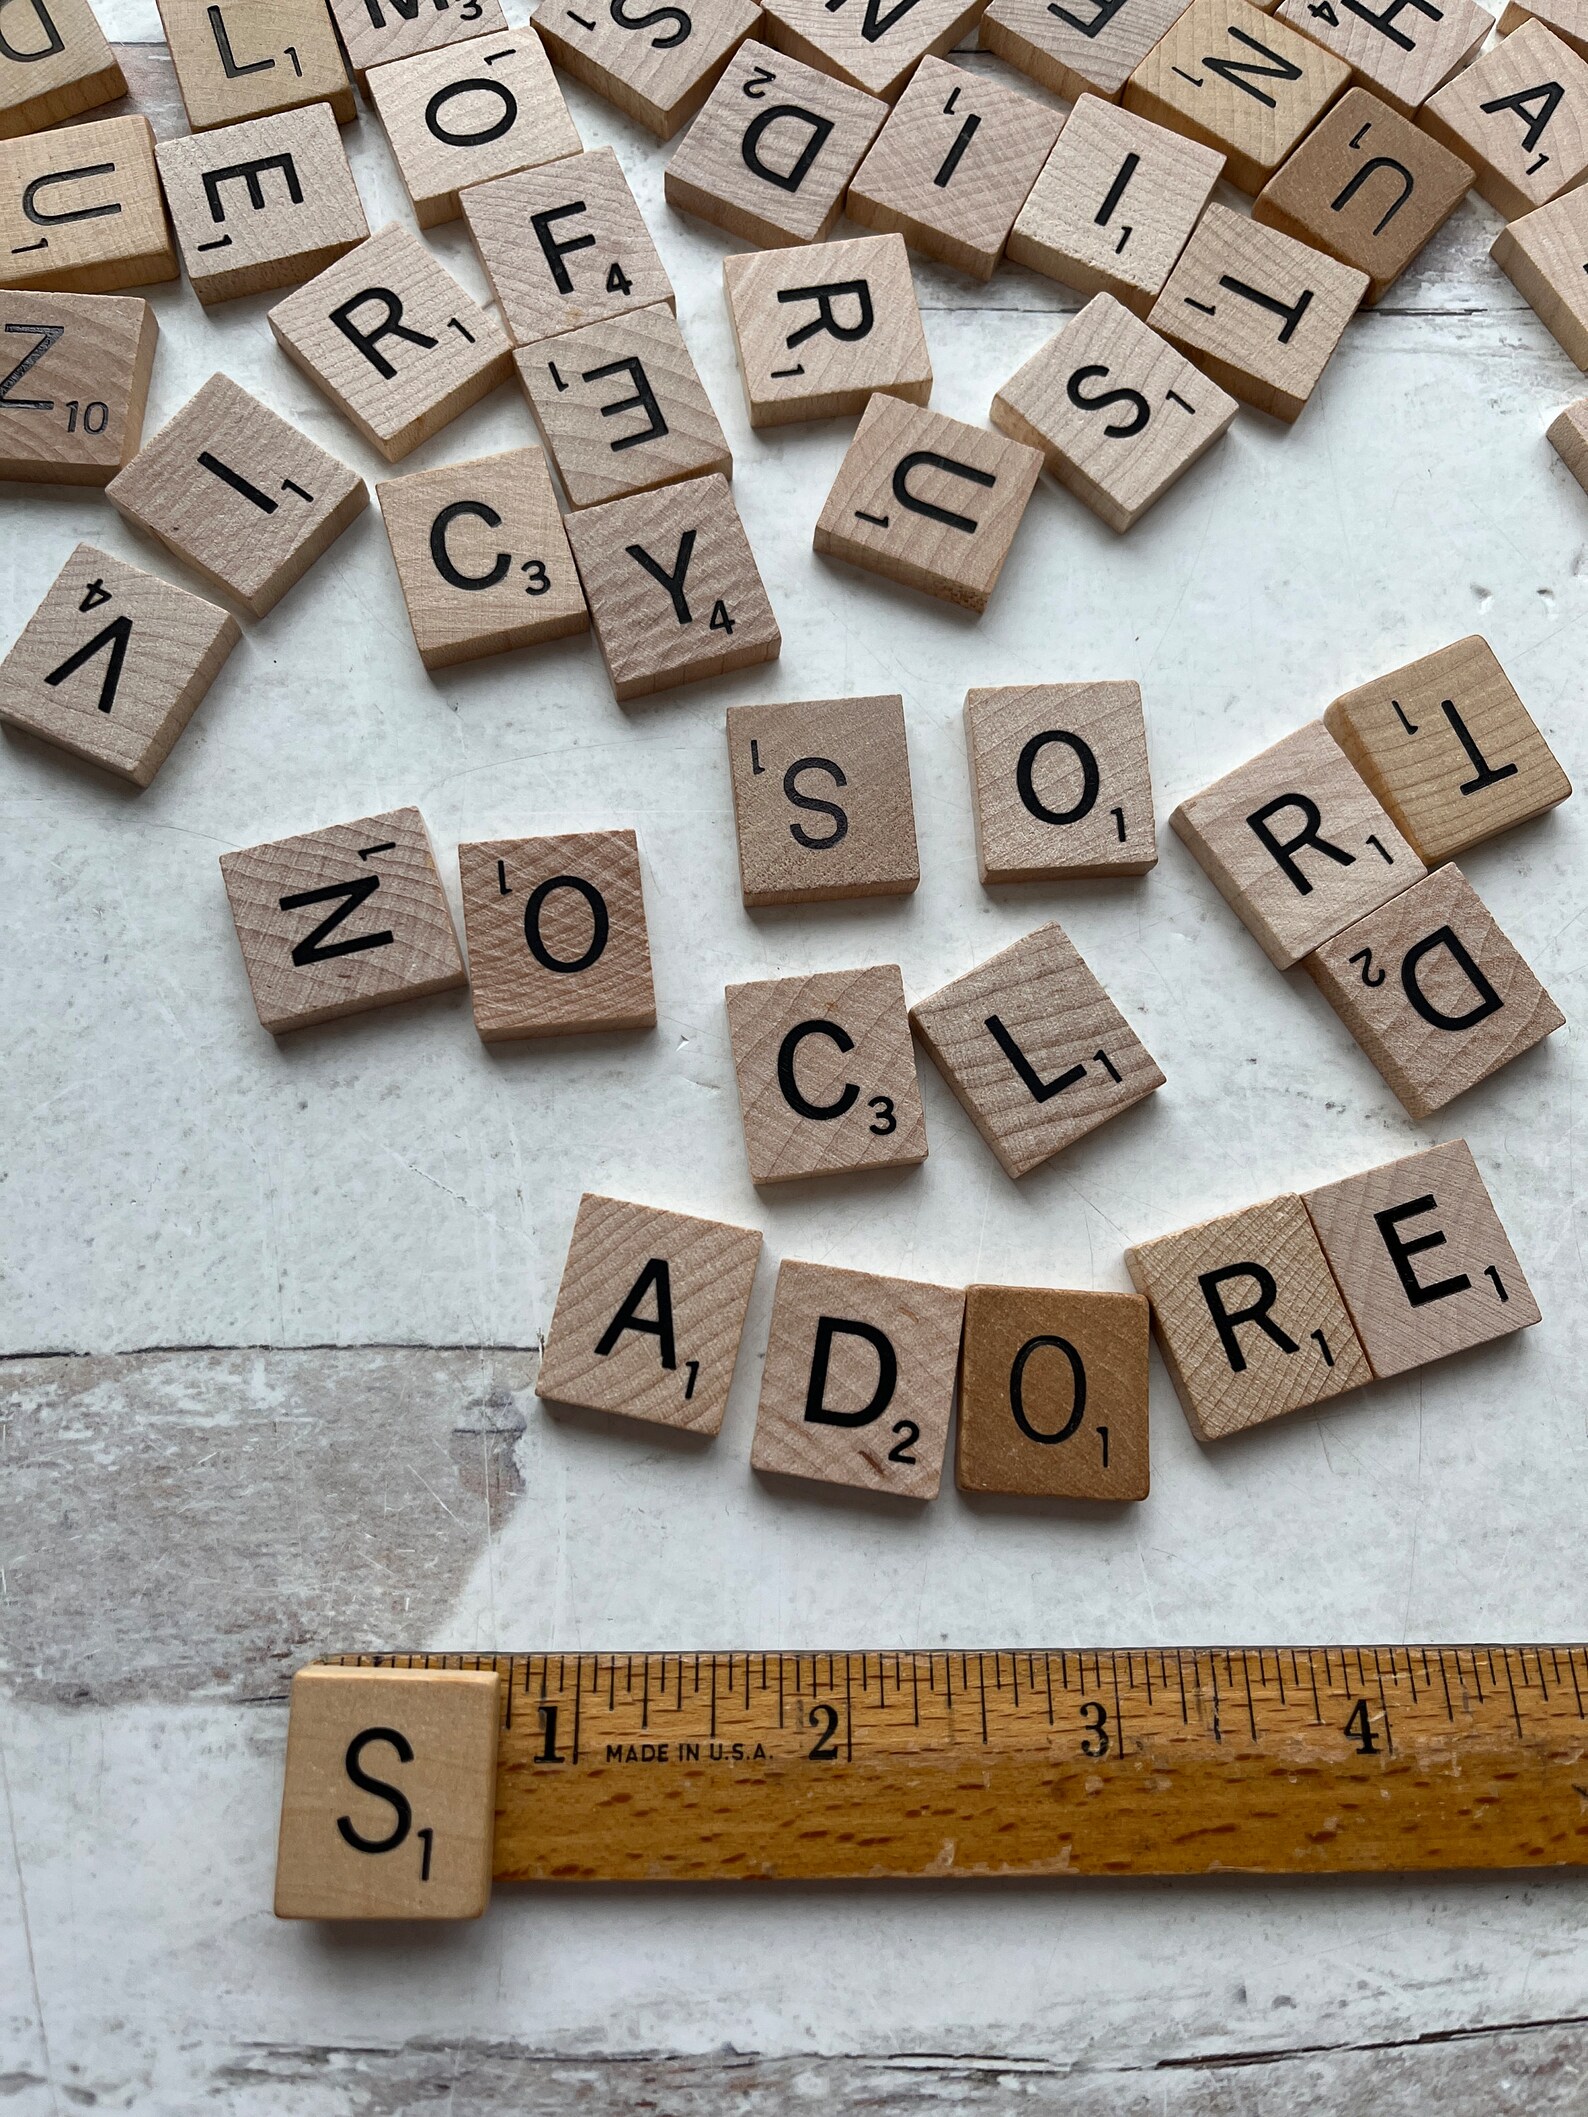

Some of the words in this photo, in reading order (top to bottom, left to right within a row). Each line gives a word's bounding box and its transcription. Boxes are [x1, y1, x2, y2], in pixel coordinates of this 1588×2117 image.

[205, 3, 277, 80] L
[283, 46, 303, 77] 1
[742, 66, 777, 99] 2
[1171, 66, 1204, 88] 1
[1200, 25, 1304, 110] N
[423, 76, 519, 148] O
[483, 48, 517, 66] 1
[1348, 122, 1372, 150] 1
[1478, 80, 1566, 154] A
[1525, 152, 1550, 176] 1
[200, 151, 305, 225] E
[740, 103, 837, 195] D
[932, 112, 983, 189] I
[1092, 151, 1142, 228] I
[21, 161, 123, 227] U
[1329, 155, 1416, 238] U
[11, 237, 49, 254] 1
[197, 234, 233, 252] 1
[528, 199, 597, 296] F
[605, 262, 633, 296] 4
[327, 286, 440, 382] R
[446, 317, 476, 344] 1
[775, 278, 875, 351] R
[1183, 297, 1216, 316] 1
[1217, 273, 1316, 346] T
[0, 322, 66, 412] Z
[65, 400, 110, 435] 10
[547, 361, 569, 393] 1
[580, 355, 671, 454] E
[770, 363, 805, 379] 1
[1065, 363, 1152, 440] S
[1165, 389, 1196, 415] 1
[195, 450, 280, 516] I
[854, 510, 890, 529] 1
[891, 449, 998, 535] U
[428, 499, 513, 592] C
[520, 559, 552, 596] 3
[623, 528, 698, 626] Y
[709, 599, 736, 635] 4
[78, 578, 113, 613] 4
[42, 614, 135, 715] V
[750, 739, 766, 776] 1
[1391, 700, 1419, 736] 1
[1439, 698, 1520, 797] T
[782, 755, 850, 851] S
[1015, 728, 1101, 827] O
[1110, 806, 1127, 843] 1
[497, 859, 514, 897] 1
[1244, 791, 1358, 897] R
[1365, 834, 1394, 865] 1
[277, 873, 396, 969] N
[522, 873, 613, 975] O
[1348, 947, 1387, 988] 2
[1399, 923, 1506, 1033] D
[775, 1017, 862, 1123] C
[867, 1095, 897, 1136] 3
[982, 1013, 1089, 1105] L
[1092, 1049, 1123, 1084] 1
[1372, 1192, 1474, 1310] E
[1483, 1265, 1509, 1303] 1
[592, 1256, 679, 1373] A
[684, 1360, 700, 1401] 1
[1196, 1260, 1302, 1376] R
[1310, 1328, 1336, 1368] 1
[802, 1314, 899, 1430] D
[887, 1419, 921, 1466] 2
[1004, 1333, 1089, 1452] O
[1095, 1425, 1110, 1469] 1
[533, 1704, 566, 1764] 1
[808, 1703, 841, 1761] 2
[1078, 1701, 1110, 1758] 3
[1343, 1698, 1380, 1755] 4
[605, 1743, 670, 1764] MADE
[677, 1742, 701, 1763] IN
[708, 1741, 775, 1762] U.S.A.
[335, 1725, 416, 1856] S
[416, 1827, 434, 1882] 1
